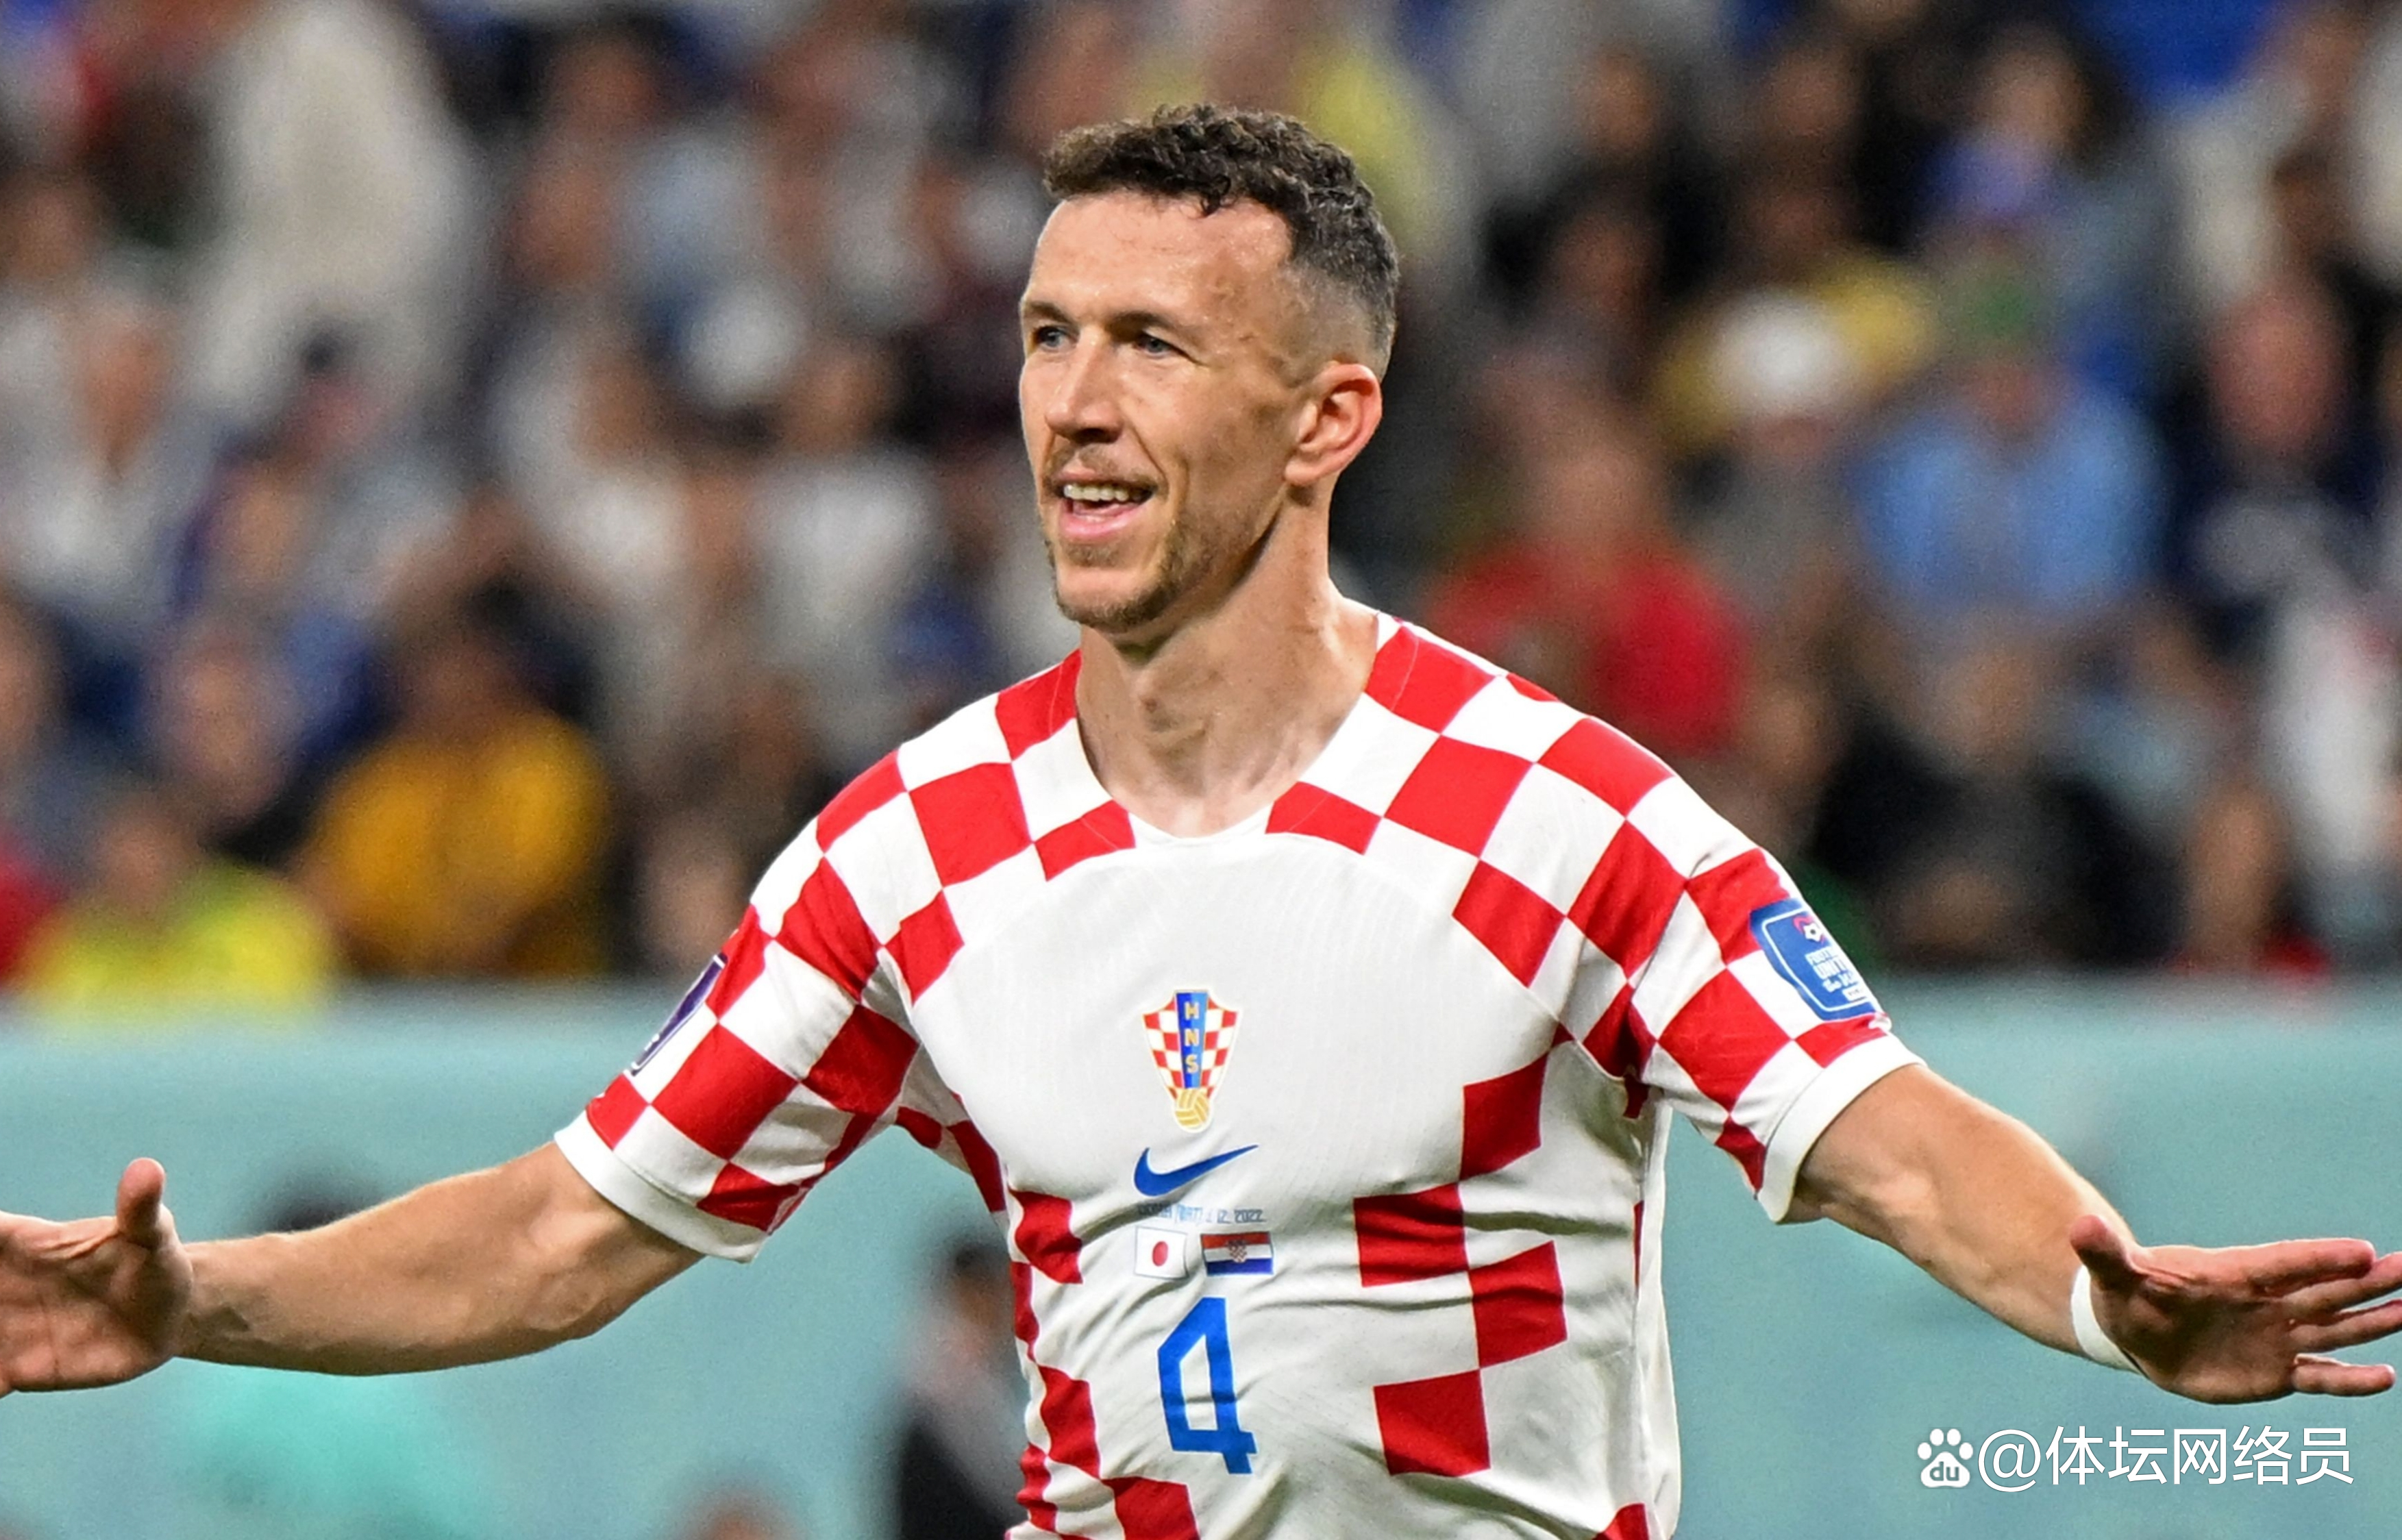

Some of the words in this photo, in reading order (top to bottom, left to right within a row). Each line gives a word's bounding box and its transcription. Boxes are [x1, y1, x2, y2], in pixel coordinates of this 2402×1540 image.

[1184, 1002, 1199, 1073] HNS
[1234, 1209, 1265, 1224] 2022
[1158, 1297, 1257, 1474] 4
